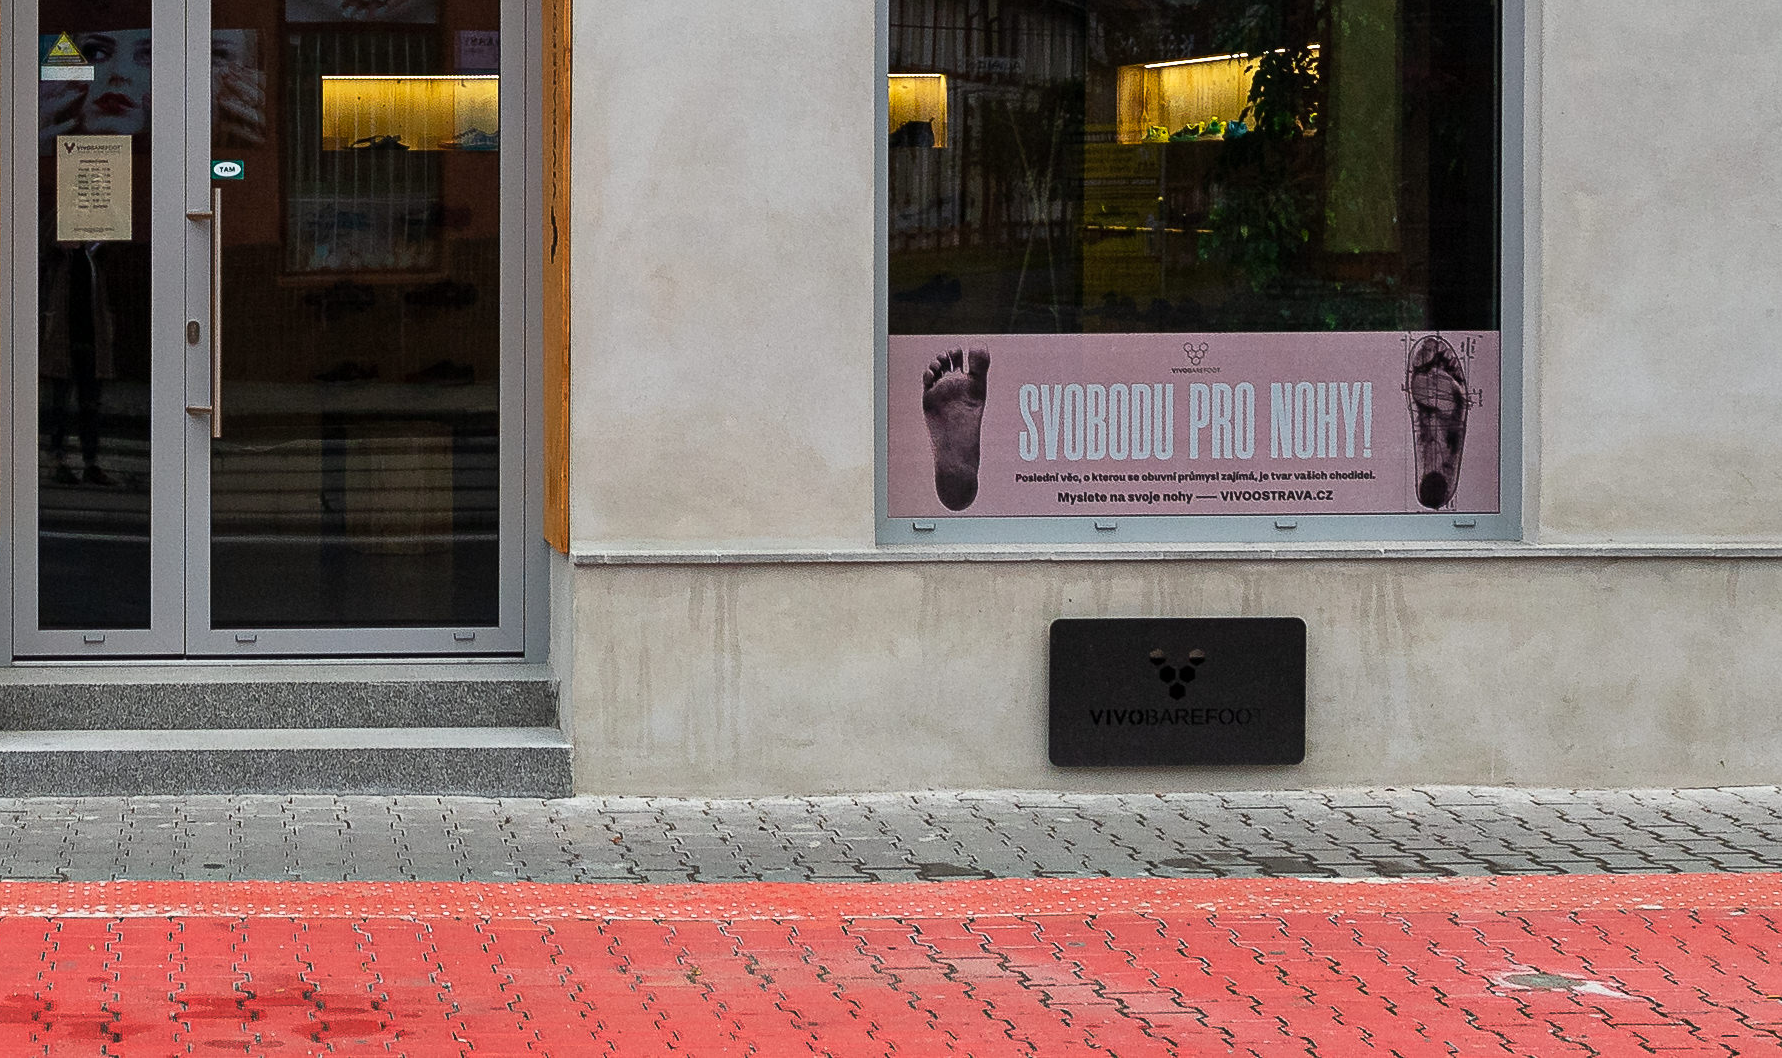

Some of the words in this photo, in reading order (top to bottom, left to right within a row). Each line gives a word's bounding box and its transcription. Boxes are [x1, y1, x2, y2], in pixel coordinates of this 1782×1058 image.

[1018, 383, 1174, 461] SVOBODU
[1189, 382, 1255, 460] PRO
[1271, 381, 1373, 460] NOHY!
[1015, 473, 1059, 482] Poslední
[1092, 472, 1126, 481] kterou
[1142, 472, 1176, 481] obuvní
[1178, 471, 1219, 483] průmysl
[1221, 471, 1258, 482] zajímá,
[1271, 472, 1292, 480] tvar
[1294, 471, 1327, 480] vašich
[1329, 470, 1376, 480] chodidel.
[1057, 492, 1108, 505] Myslete
[1109, 494, 1125, 502] na
[1127, 492, 1160, 504] svoje
[1163, 492, 1193, 504] nohy
[1220, 490, 1334, 502] VIVOOSTRAVA.CZ
